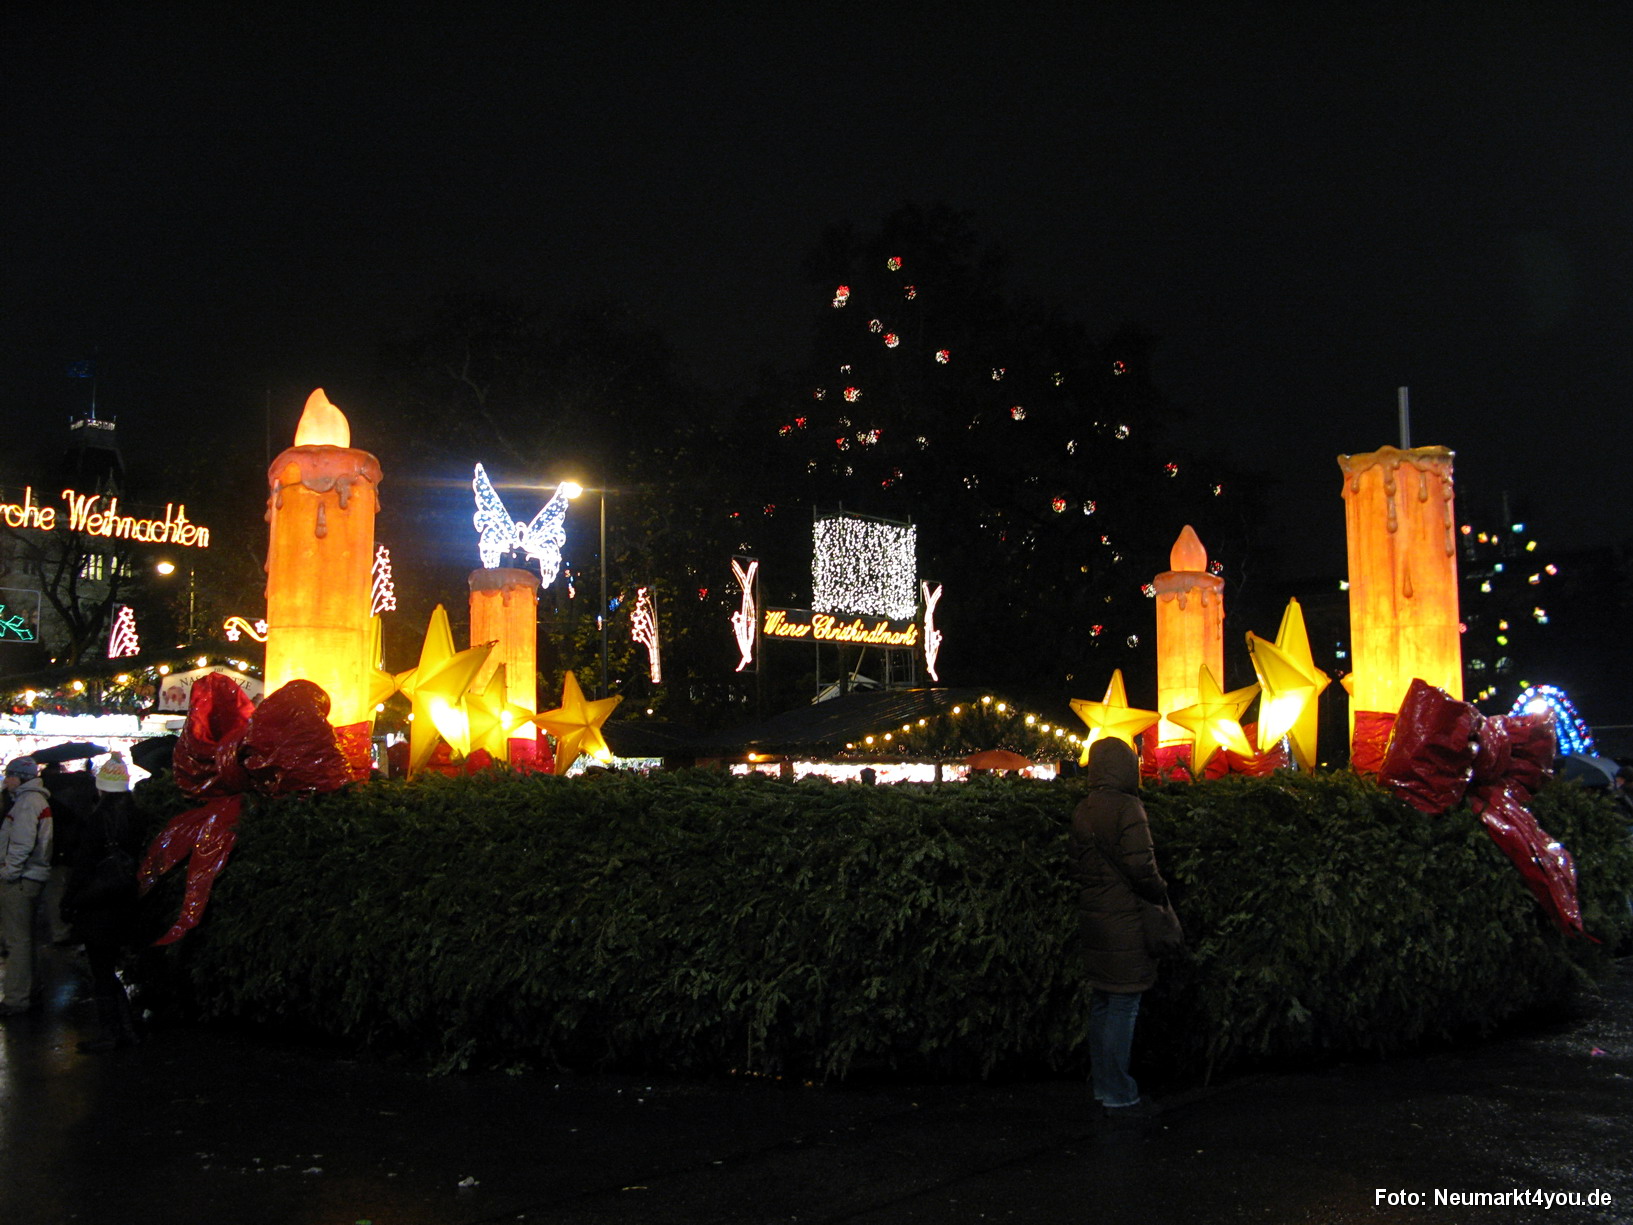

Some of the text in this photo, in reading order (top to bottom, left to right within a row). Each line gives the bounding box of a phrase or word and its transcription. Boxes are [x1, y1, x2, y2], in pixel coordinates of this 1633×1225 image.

[62, 489, 209, 547] Weihnachten
[763, 610, 919, 646] Wiener Christkindlmarkt
